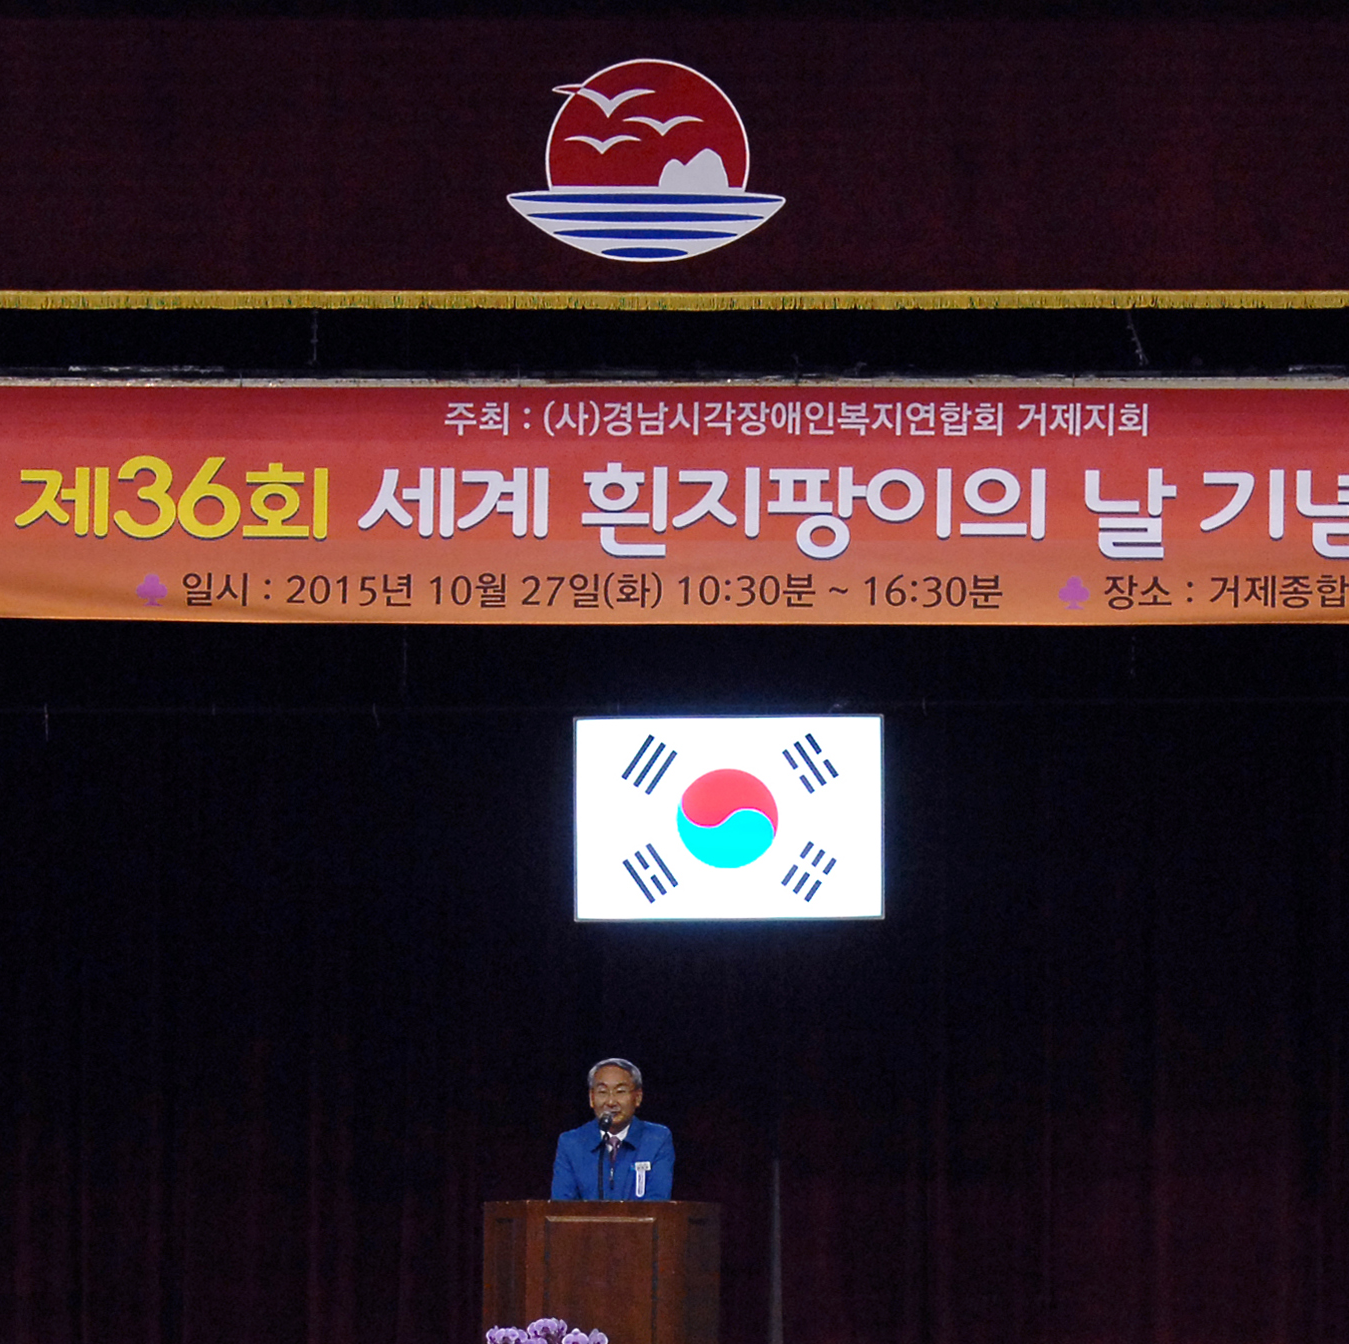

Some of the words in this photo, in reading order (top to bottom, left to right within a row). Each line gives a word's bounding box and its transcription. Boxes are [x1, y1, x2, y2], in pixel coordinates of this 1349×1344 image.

[444, 402, 509, 436] 주최
[543, 400, 1003, 437] (사)경남시각장애인복지연합회
[1016, 402, 1149, 437] 거제지회
[13, 456, 331, 541] 제36회
[356, 466, 550, 538] 세계
[580, 462, 1047, 559] 흰지팡이의
[1083, 467, 1178, 559] 날
[181, 571, 249, 607] 일시
[285, 573, 412, 607] 2015년
[428, 572, 508, 607] 10월
[520, 571, 663, 609] 27일(화)
[677, 573, 816, 608] 10:30분
[863, 573, 1003, 609] 16:30분
[1103, 573, 1172, 609] 장소
